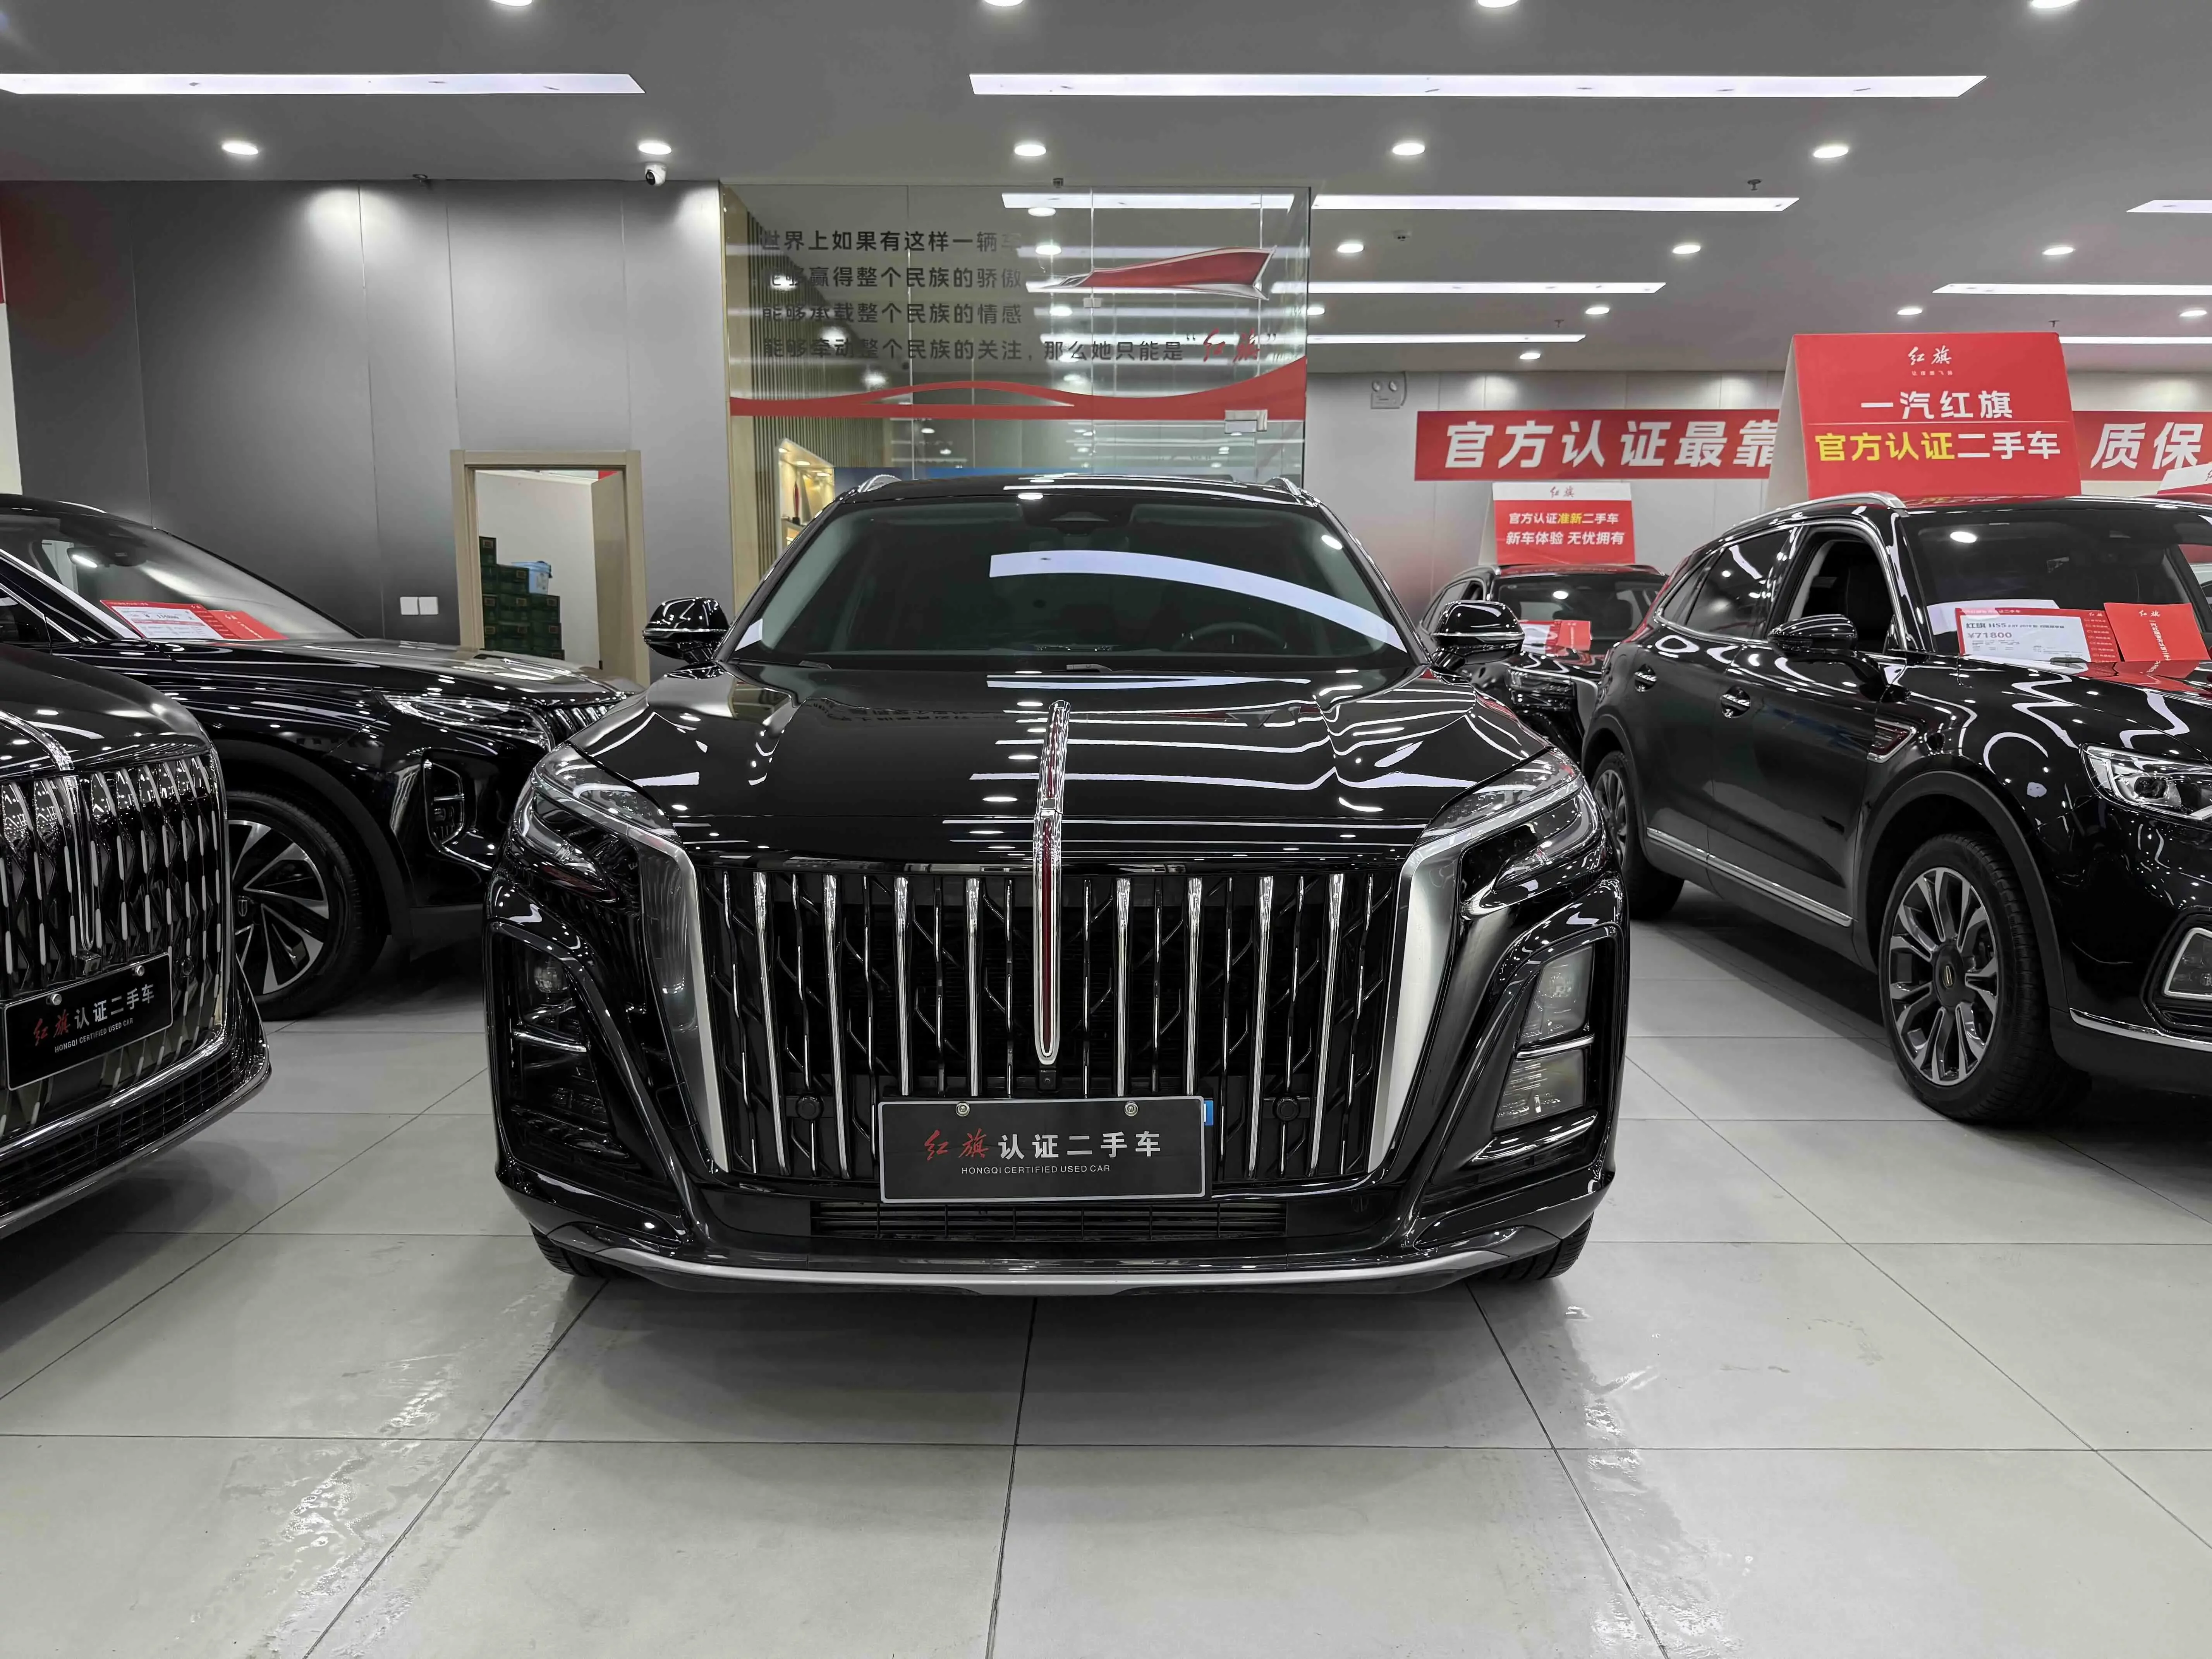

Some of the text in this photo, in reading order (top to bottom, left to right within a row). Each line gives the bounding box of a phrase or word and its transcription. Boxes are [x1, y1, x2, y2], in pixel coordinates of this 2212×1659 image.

[763, 302, 1022, 324] 能够承载整个民族的情感
[1908, 345, 1952, 366] 红旗
[1861, 391, 2013, 419] 一汽红旗
[1444, 419, 1778, 469] 官方认证最靠
[1815, 431, 2061, 461] 官方认证二手车
[2090, 421, 2203, 470] 质保
[1550, 486, 1575, 498] 红旗
[1509, 512, 1619, 525] 官方认证准新二手车
[1506, 532, 1625, 545] 新车体验 无忧拥有
[33, 984, 155, 1046] 红旗认证二手车
[55, 1018, 133, 1053] HONGQI CERTIFIED USED CAR
[924, 1128, 1161, 1161] 红旗认证二手车
[1004, 1166, 1058, 1174] CERTIFIED
[1061, 1165, 1087, 1173] USED
